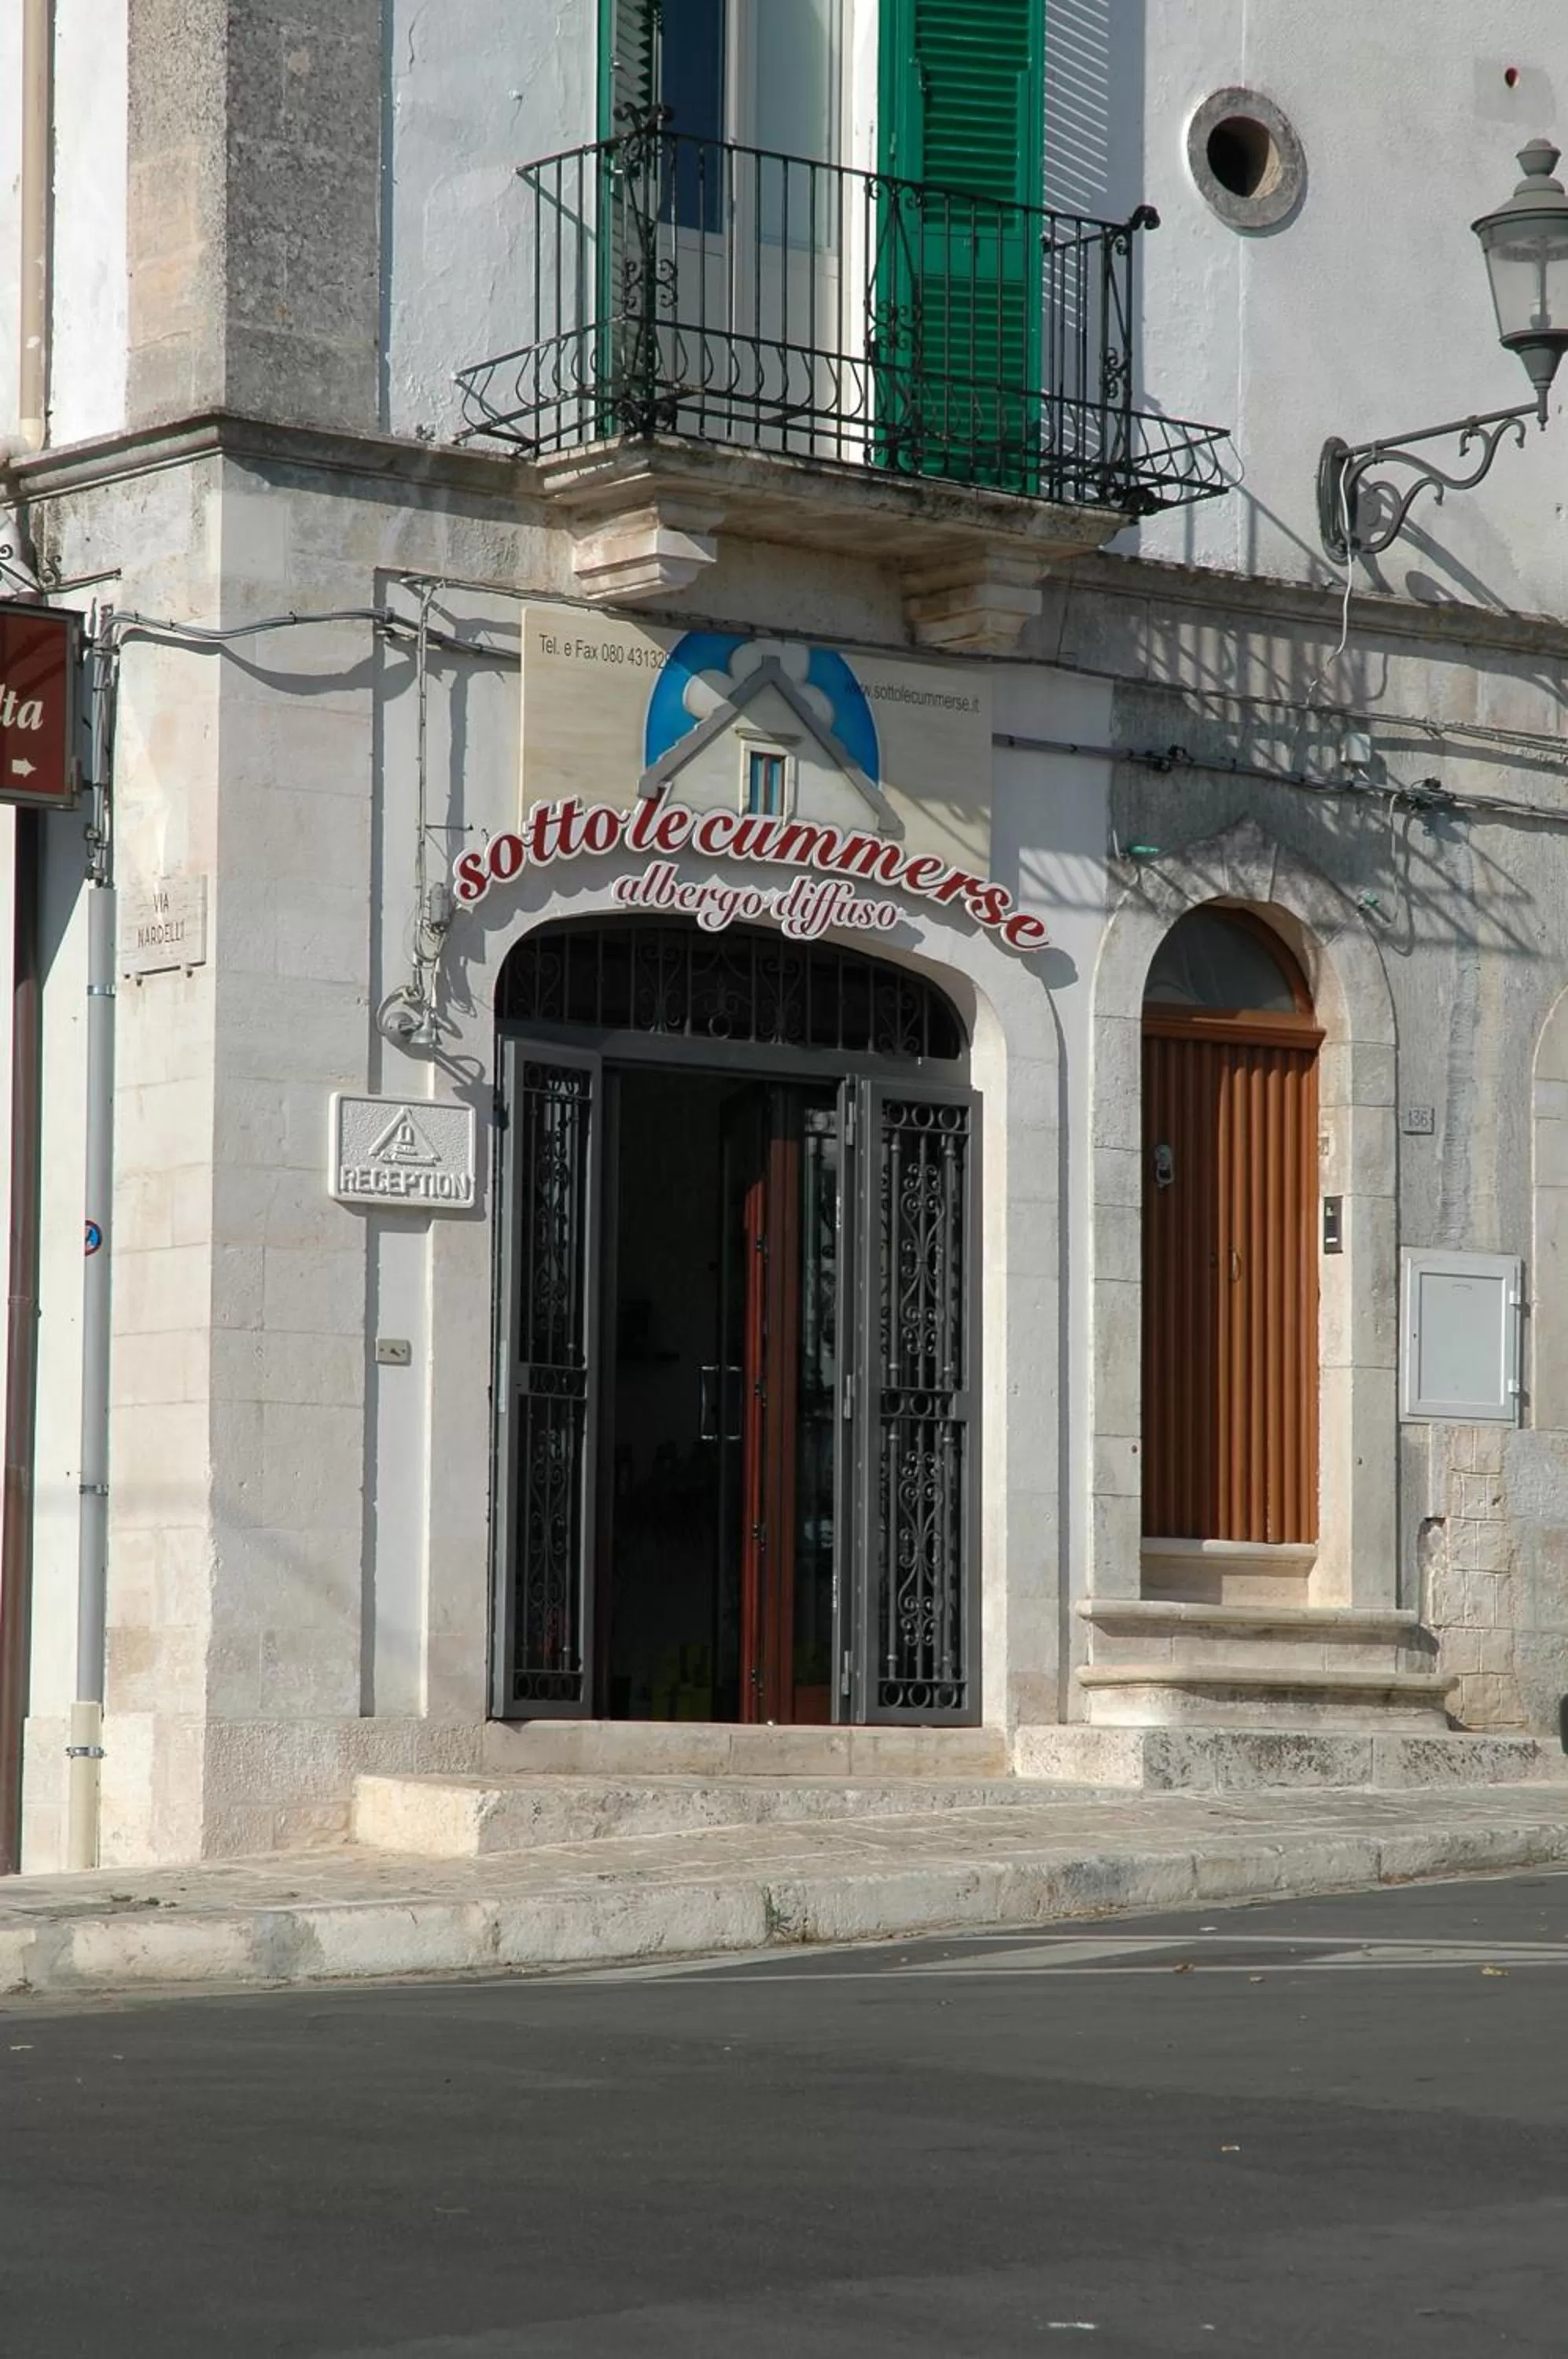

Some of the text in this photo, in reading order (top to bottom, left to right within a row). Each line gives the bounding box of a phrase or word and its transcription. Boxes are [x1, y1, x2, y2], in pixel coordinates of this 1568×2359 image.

[539, 633, 560, 655] Tel.
[563, 641, 572, 657] e
[575, 639, 598, 661] Fax
[601, 643, 624, 664] 080
[153, 892, 170, 913] VIA
[616, 863, 899, 936] albergo diffuso
[137, 920, 186, 949] NARDELLI
[340, 1165, 471, 1201] RECEPTION
